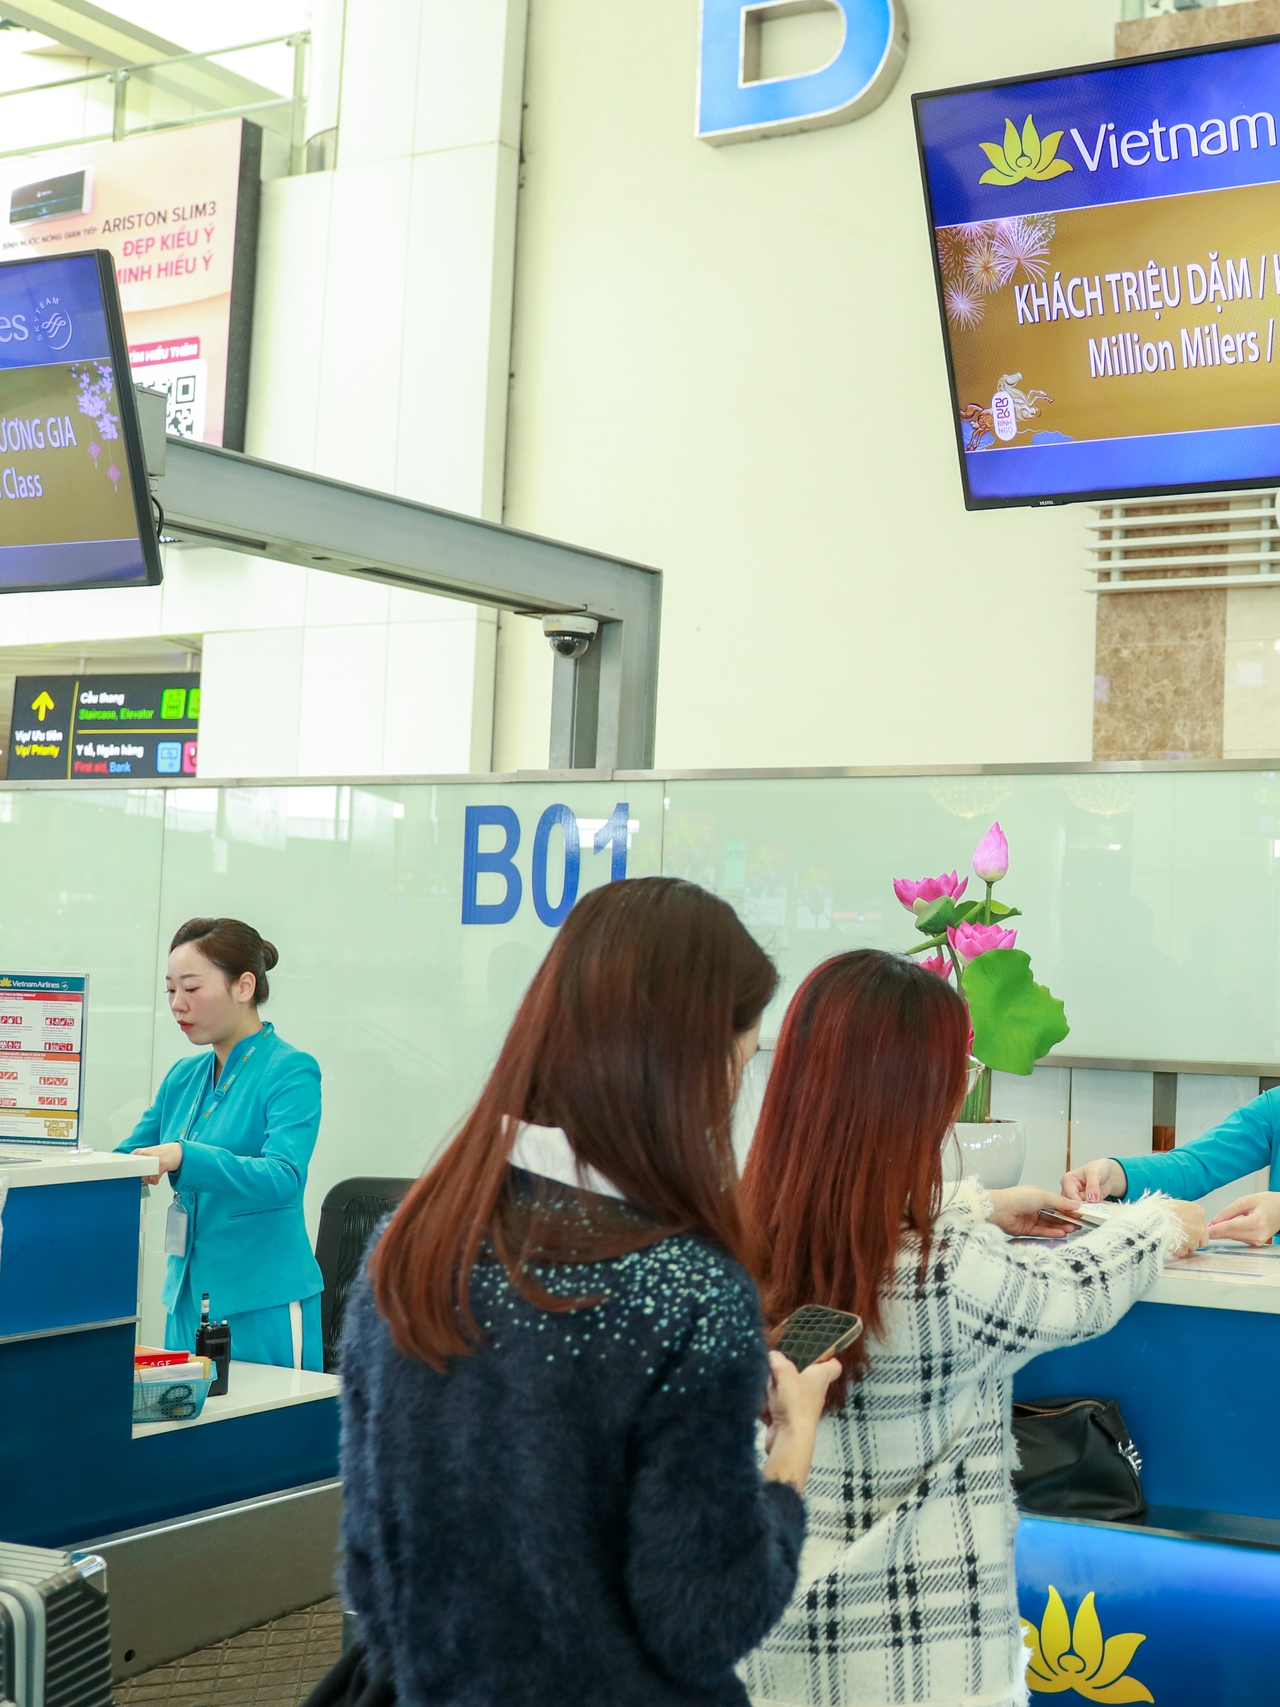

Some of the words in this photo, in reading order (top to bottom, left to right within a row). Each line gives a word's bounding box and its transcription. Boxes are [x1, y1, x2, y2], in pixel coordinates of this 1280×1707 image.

[1070, 111, 1276, 173] Vietnam
[102, 210, 167, 234] ARISTON
[172, 201, 216, 222] SLIM3
[123, 237, 155, 259] ĐẸP
[204, 223, 215, 243] Ý
[203, 250, 213, 270] Ý
[1015, 268, 1102, 324] KHÁCH
[1107, 262, 1180, 320] TRIỆU
[1188, 253, 1253, 314] DẶM
[1258, 254, 1267, 299] /
[1088, 322, 1177, 378] Million
[1181, 325, 1259, 368] Milers
[1266, 319, 1275, 361] /
[46, 416, 78, 449] GIA
[2, 467, 44, 499] Class
[120, 708, 154, 720] Elevator
[110, 761, 131, 772] Bank
[461, 802, 629, 928] B01
